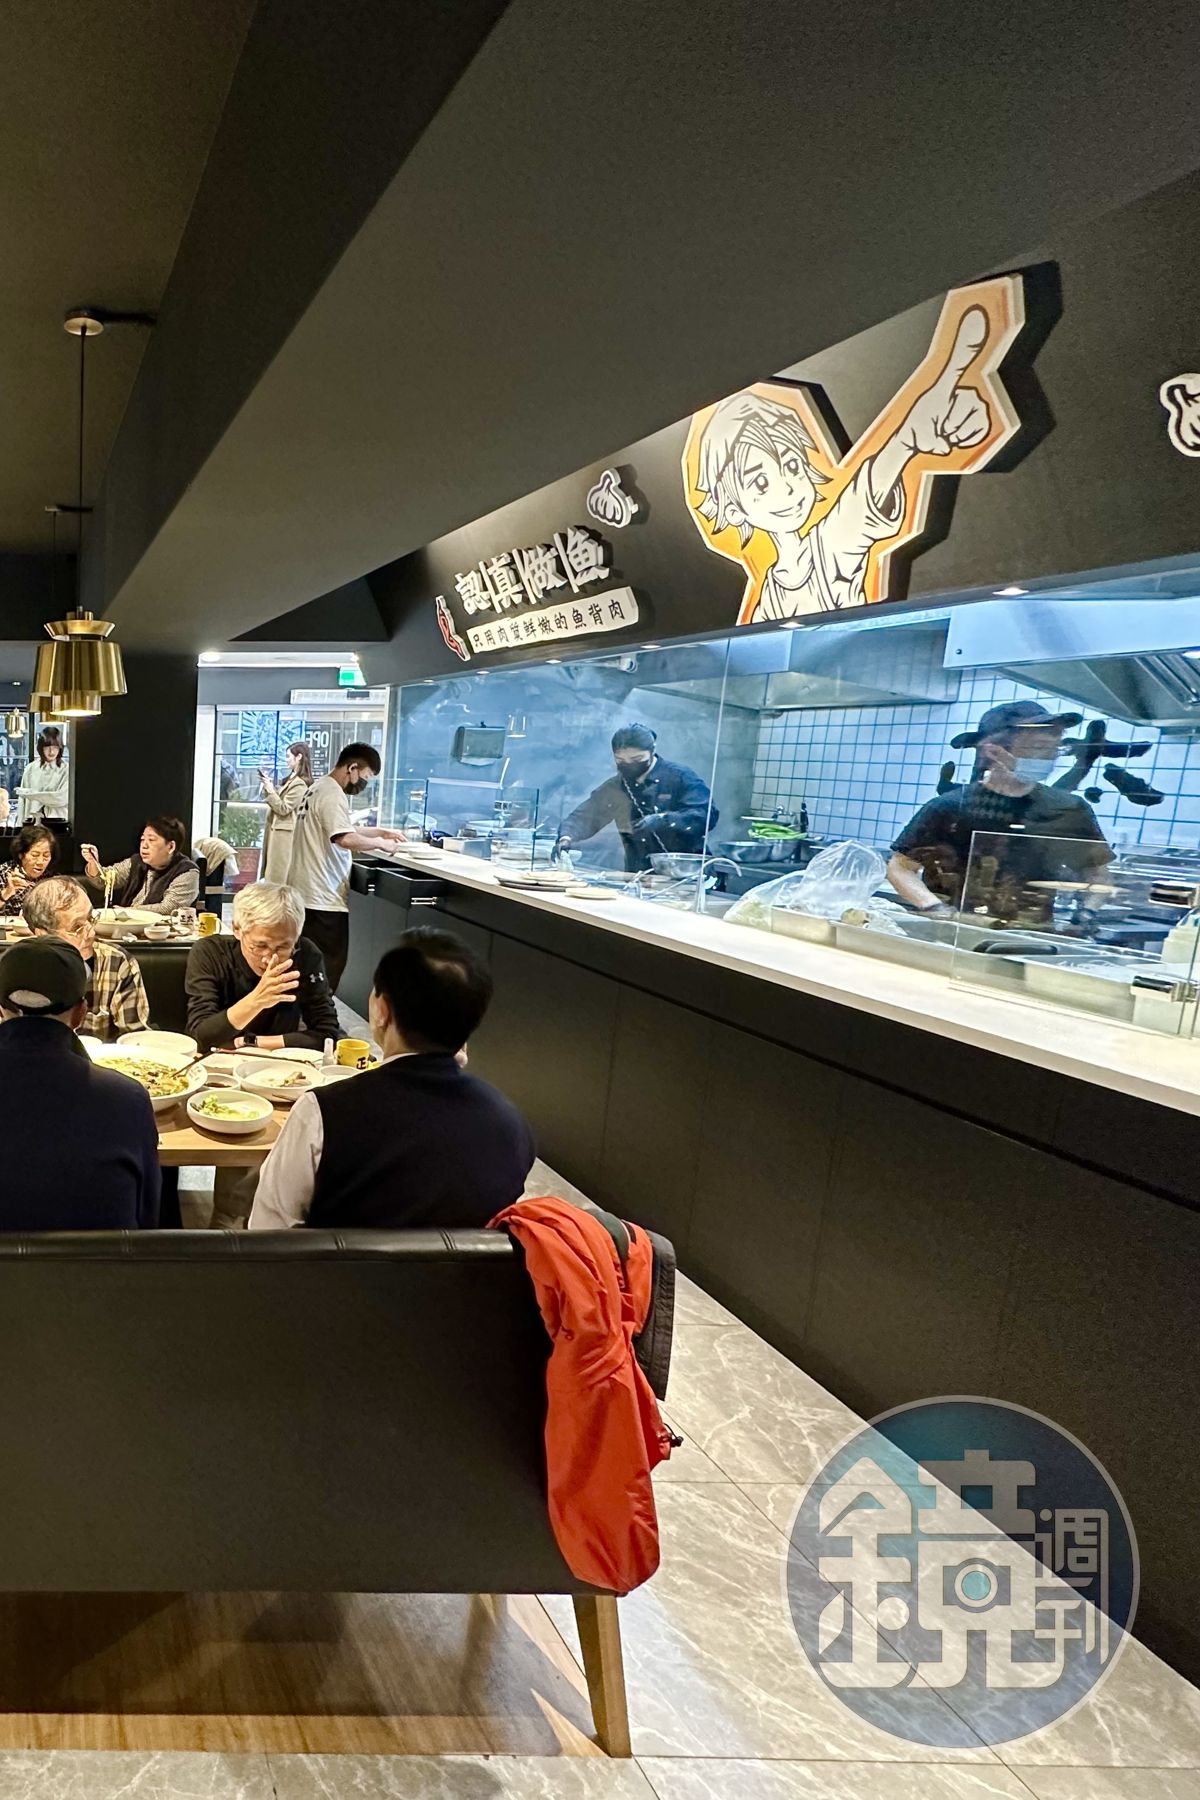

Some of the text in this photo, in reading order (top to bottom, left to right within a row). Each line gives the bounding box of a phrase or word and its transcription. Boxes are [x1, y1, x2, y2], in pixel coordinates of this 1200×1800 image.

[454, 528, 610, 615] 認真做魚
[473, 600, 626, 647] 只用肉質鮮嫩的魚背肉
